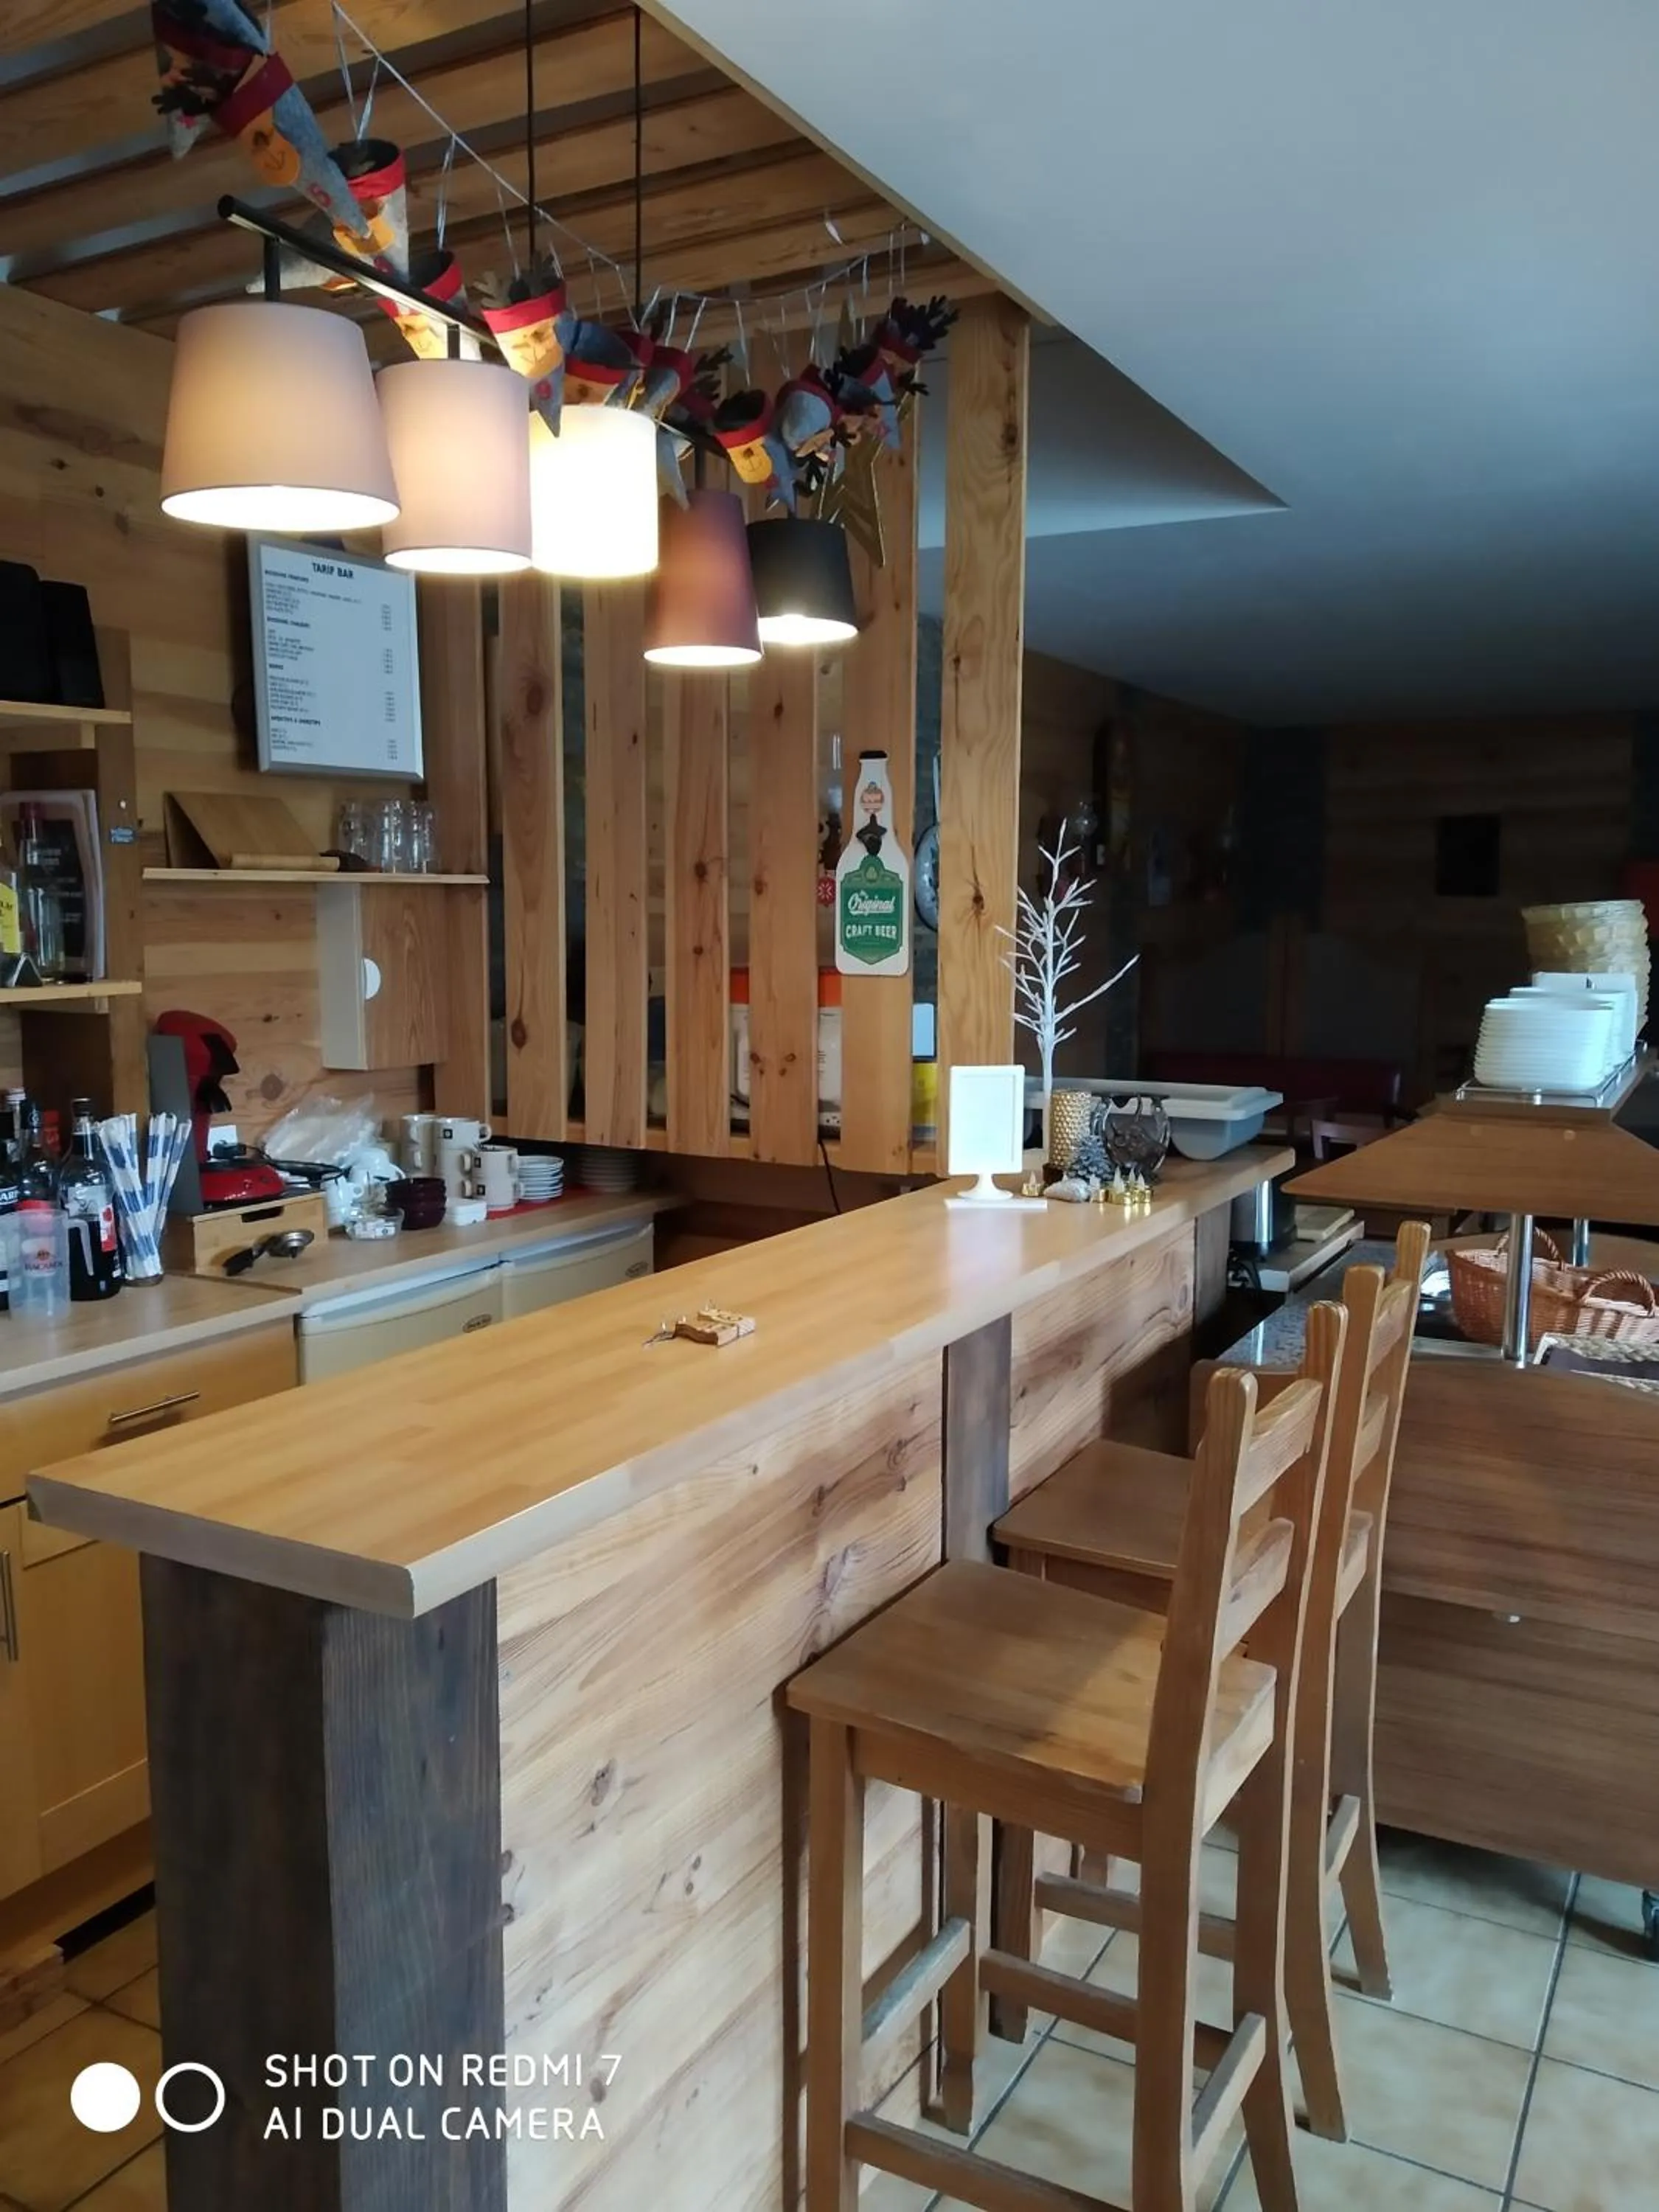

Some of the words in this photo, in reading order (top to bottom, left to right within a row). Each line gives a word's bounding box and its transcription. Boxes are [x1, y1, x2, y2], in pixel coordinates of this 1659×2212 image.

[312, 562, 334, 575] TARIF
[337, 566, 355, 579] BAR
[847, 889, 896, 916] Original
[846, 925, 872, 939] CRAFT
[875, 925, 897, 939] BEER
